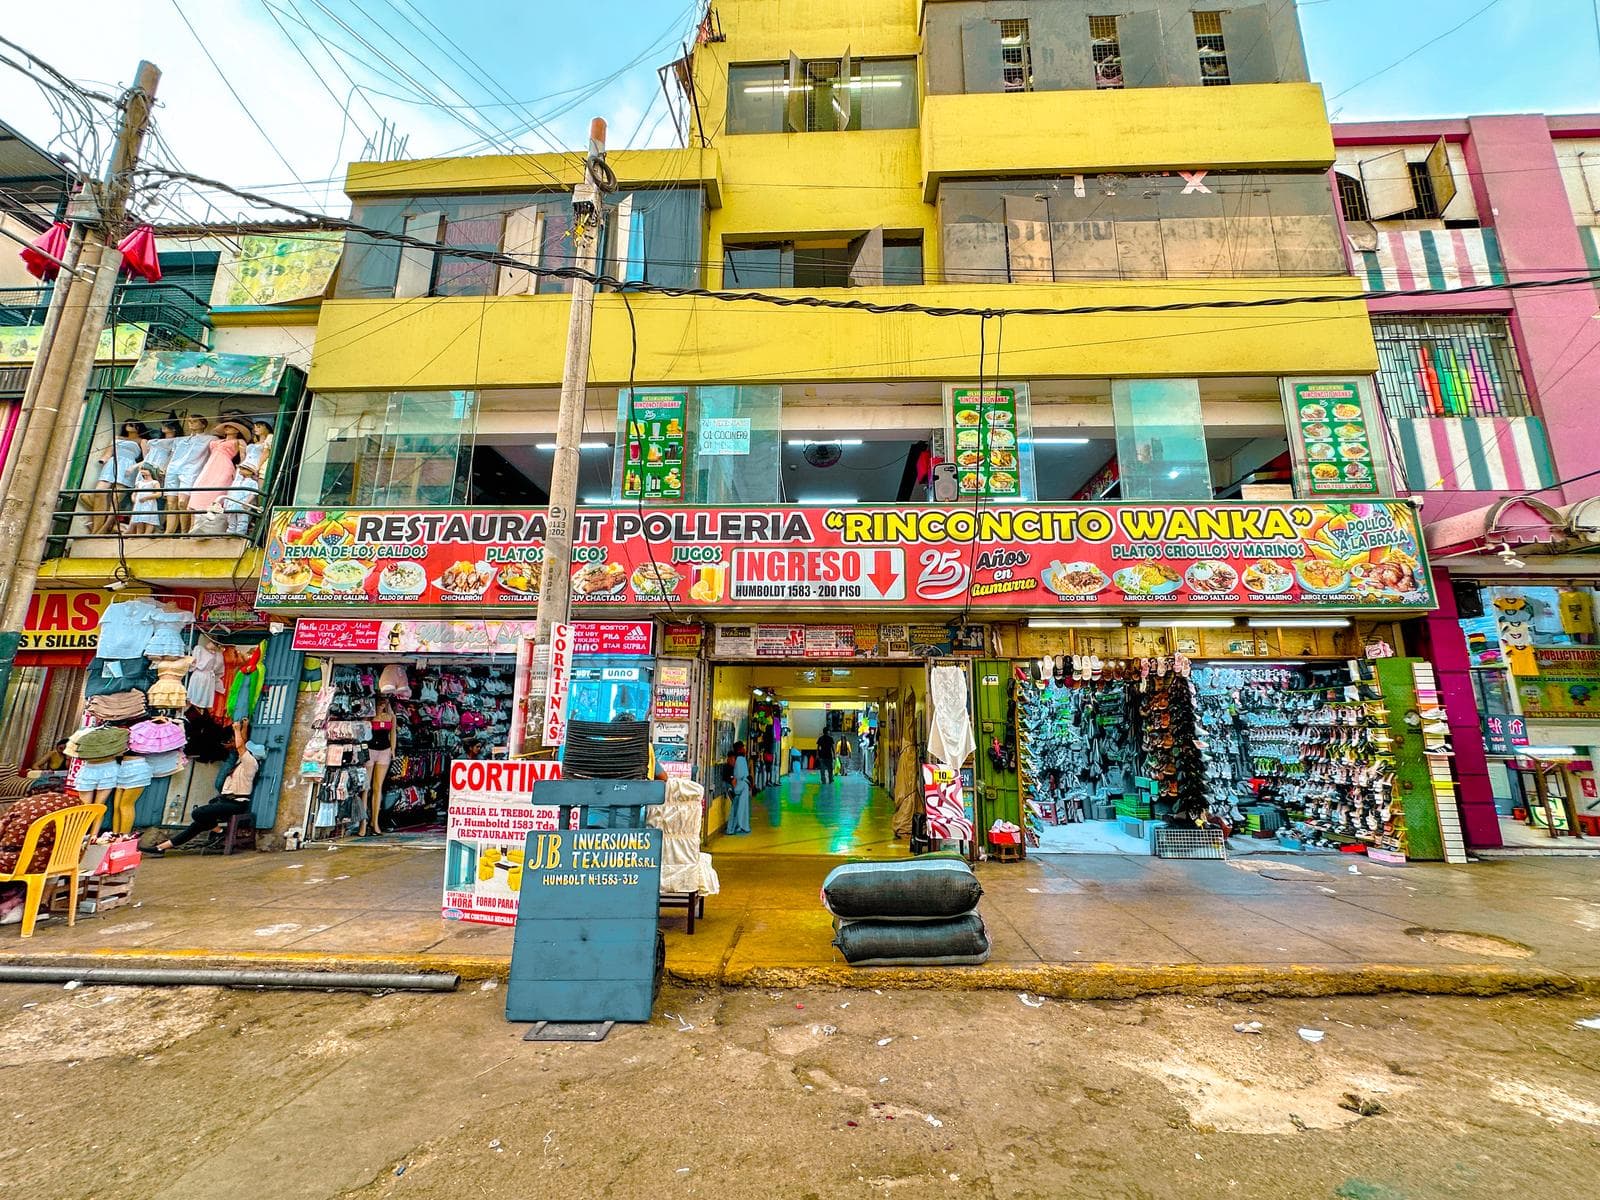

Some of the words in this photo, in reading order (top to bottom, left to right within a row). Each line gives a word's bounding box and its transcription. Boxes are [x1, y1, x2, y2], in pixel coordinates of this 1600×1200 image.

[357, 516, 605, 542] RESTAURAT
[615, 514, 812, 541] POLLERIA
[1347, 515, 1393, 533] POLLOS
[1340, 542, 1348, 551] A
[1350, 536, 1366, 549] LA
[1368, 529, 1408, 548] BRASA
[285, 546, 328, 557] REYNA
[330, 546, 346, 557] DE
[350, 546, 374, 557] LOS
[376, 546, 428, 558] CALDOS
[486, 548, 544, 562] PLATOS
[672, 547, 722, 562] JUGOS
[1112, 544, 1162, 558] PLATOS
[1164, 544, 1228, 558] CRIOLLOS
[1230, 544, 1240, 557] Y
[1243, 544, 1305, 557] MARINOS
[976, 548, 1030, 570] Años
[736, 551, 861, 582] INGRESO
[915, 549, 972, 600] 25
[993, 568, 1013, 581] en
[736, 585, 786, 597] HUMBOLDT
[788, 586, 811, 597] 1583
[818, 585, 836, 597] 2DO
[840, 585, 860, 597] PISO
[971, 578, 1037, 598] Gamarra
[586, 594, 627, 602] CHACTADO
[34, 635, 42, 647] Y
[46, 634, 98, 648] SILLAS
[549, 625, 567, 740] CORTINAS
[451, 762, 563, 792] CORTINA
[449, 804, 487, 816] GALERÍA
[488, 808, 499, 817] EL
[500, 808, 534, 818] TREBOL
[451, 818, 463, 828] Jr.
[464, 818, 510, 829] Humboltd
[512, 820, 534, 830] 1583
[528, 834, 563, 870] J.B.
[574, 833, 651, 850] INVERSIONES
[572, 852, 638, 868] TEXJUBER
[542, 874, 585, 885] HUMBOLT
[452, 898, 472, 909] HORA
[476, 896, 496, 908] FORRO
[498, 898, 514, 910] PARA
